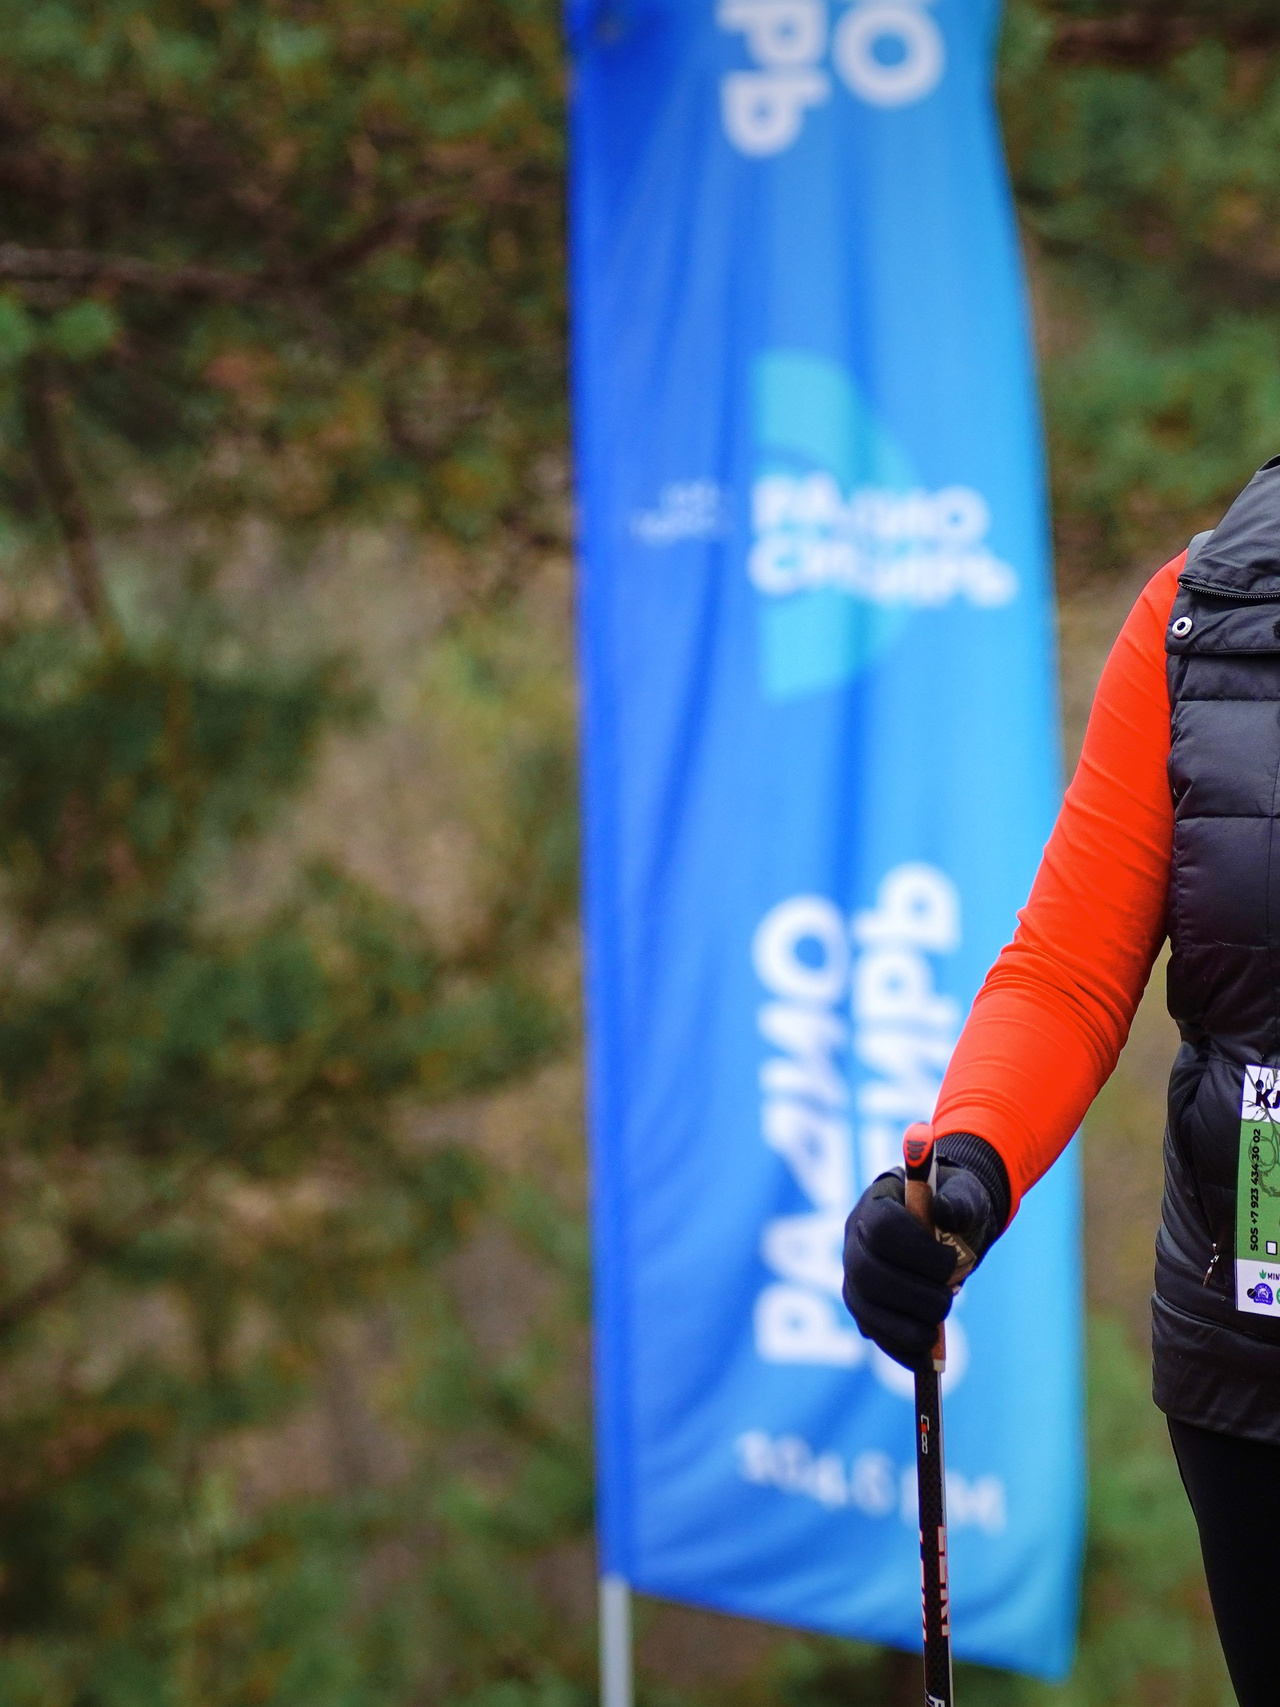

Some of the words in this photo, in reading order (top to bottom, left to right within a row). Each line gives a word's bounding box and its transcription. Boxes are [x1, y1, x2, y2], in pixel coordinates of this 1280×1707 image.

[752, 894, 867, 1366] РАДИО
[1252, 1128, 1261, 1143] 02
[1251, 1146, 1260, 1160] 30
[1250, 1163, 1259, 1185] 434
[1250, 1188, 1259, 1209] 923
[1250, 1211, 1259, 1224] +7
[1250, 1227, 1259, 1251] SOS
